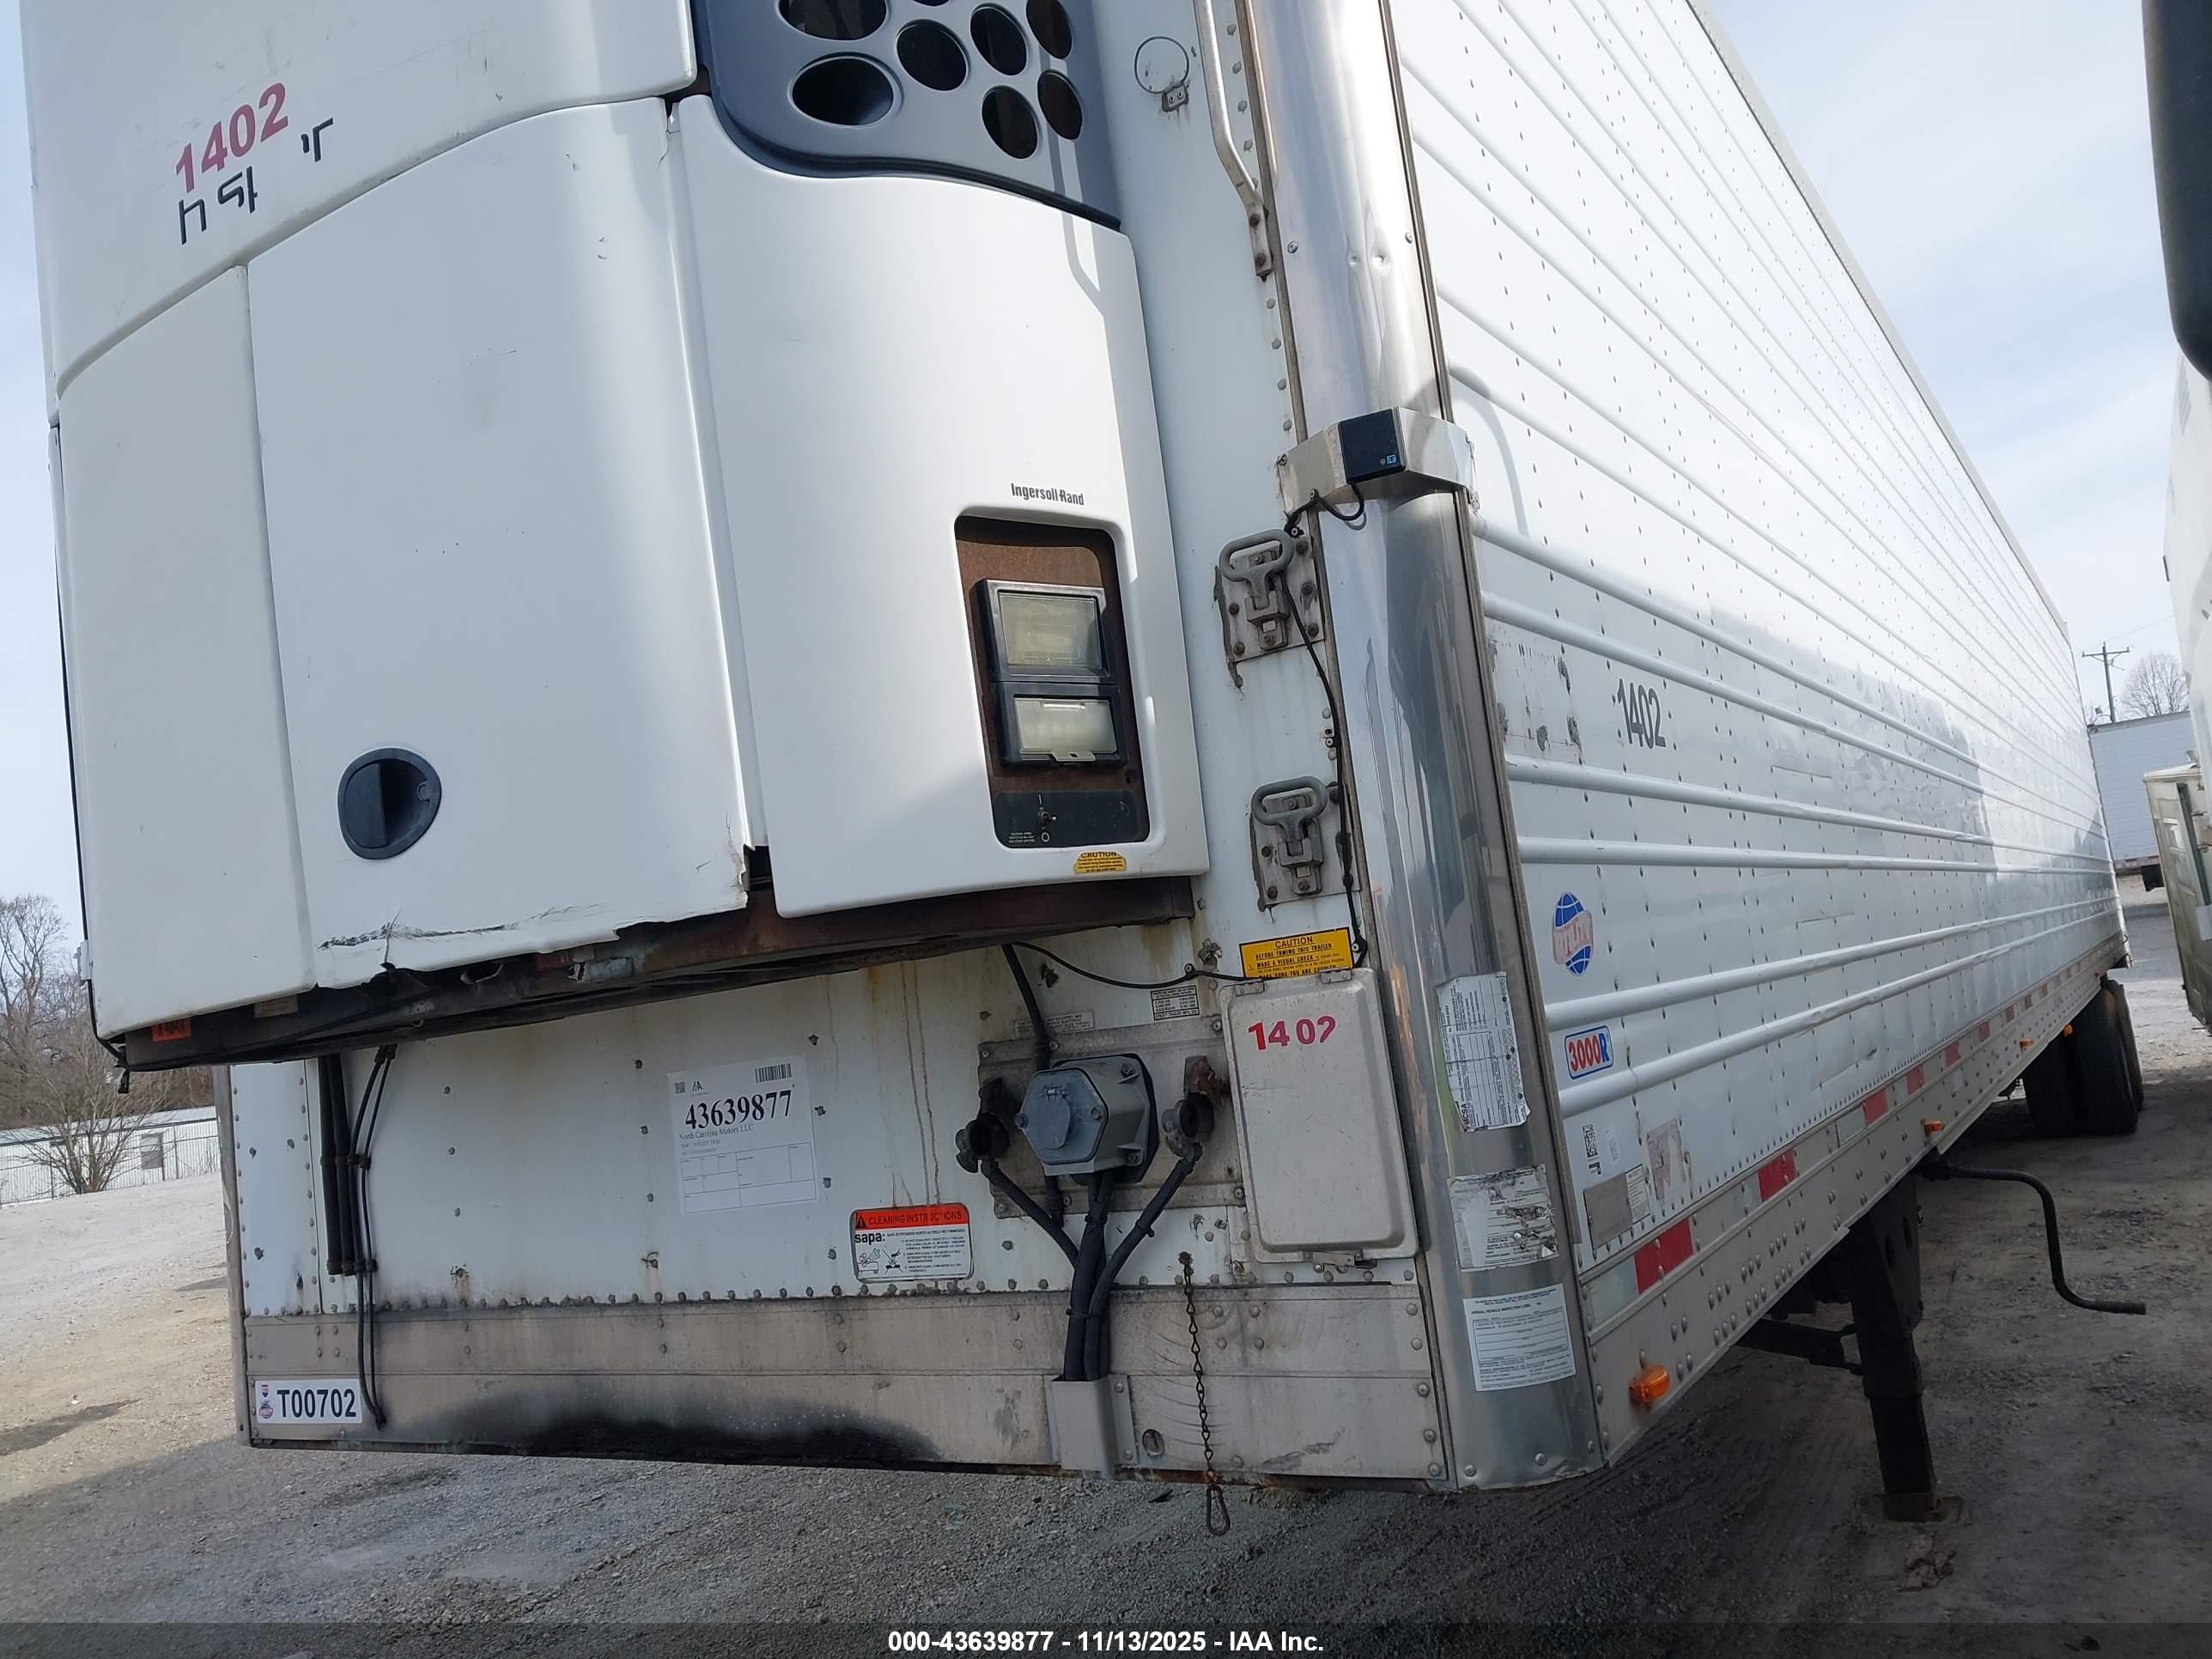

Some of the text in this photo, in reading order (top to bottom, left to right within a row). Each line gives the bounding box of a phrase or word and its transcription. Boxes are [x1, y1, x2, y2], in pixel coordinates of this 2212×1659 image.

[176, 82, 288, 193] 1402
[1617, 678, 1667, 749] 1402
[1275, 936, 1313, 949] CAUTION
[1276, 949, 1295, 957] TOWING
[1278, 956, 1295, 964] VISUAL
[1249, 1015, 1336, 1051] 1402
[1568, 1032, 1610, 1073] 3000R
[685, 1090, 791, 1129] 43639877
[679, 1131, 695, 1140] North
[695, 1129, 719, 1139] Carolina
[740, 1123, 754, 1132] LLC
[868, 1214, 907, 1225] CLEANING
[276, 1389, 356, 1419] T00702
